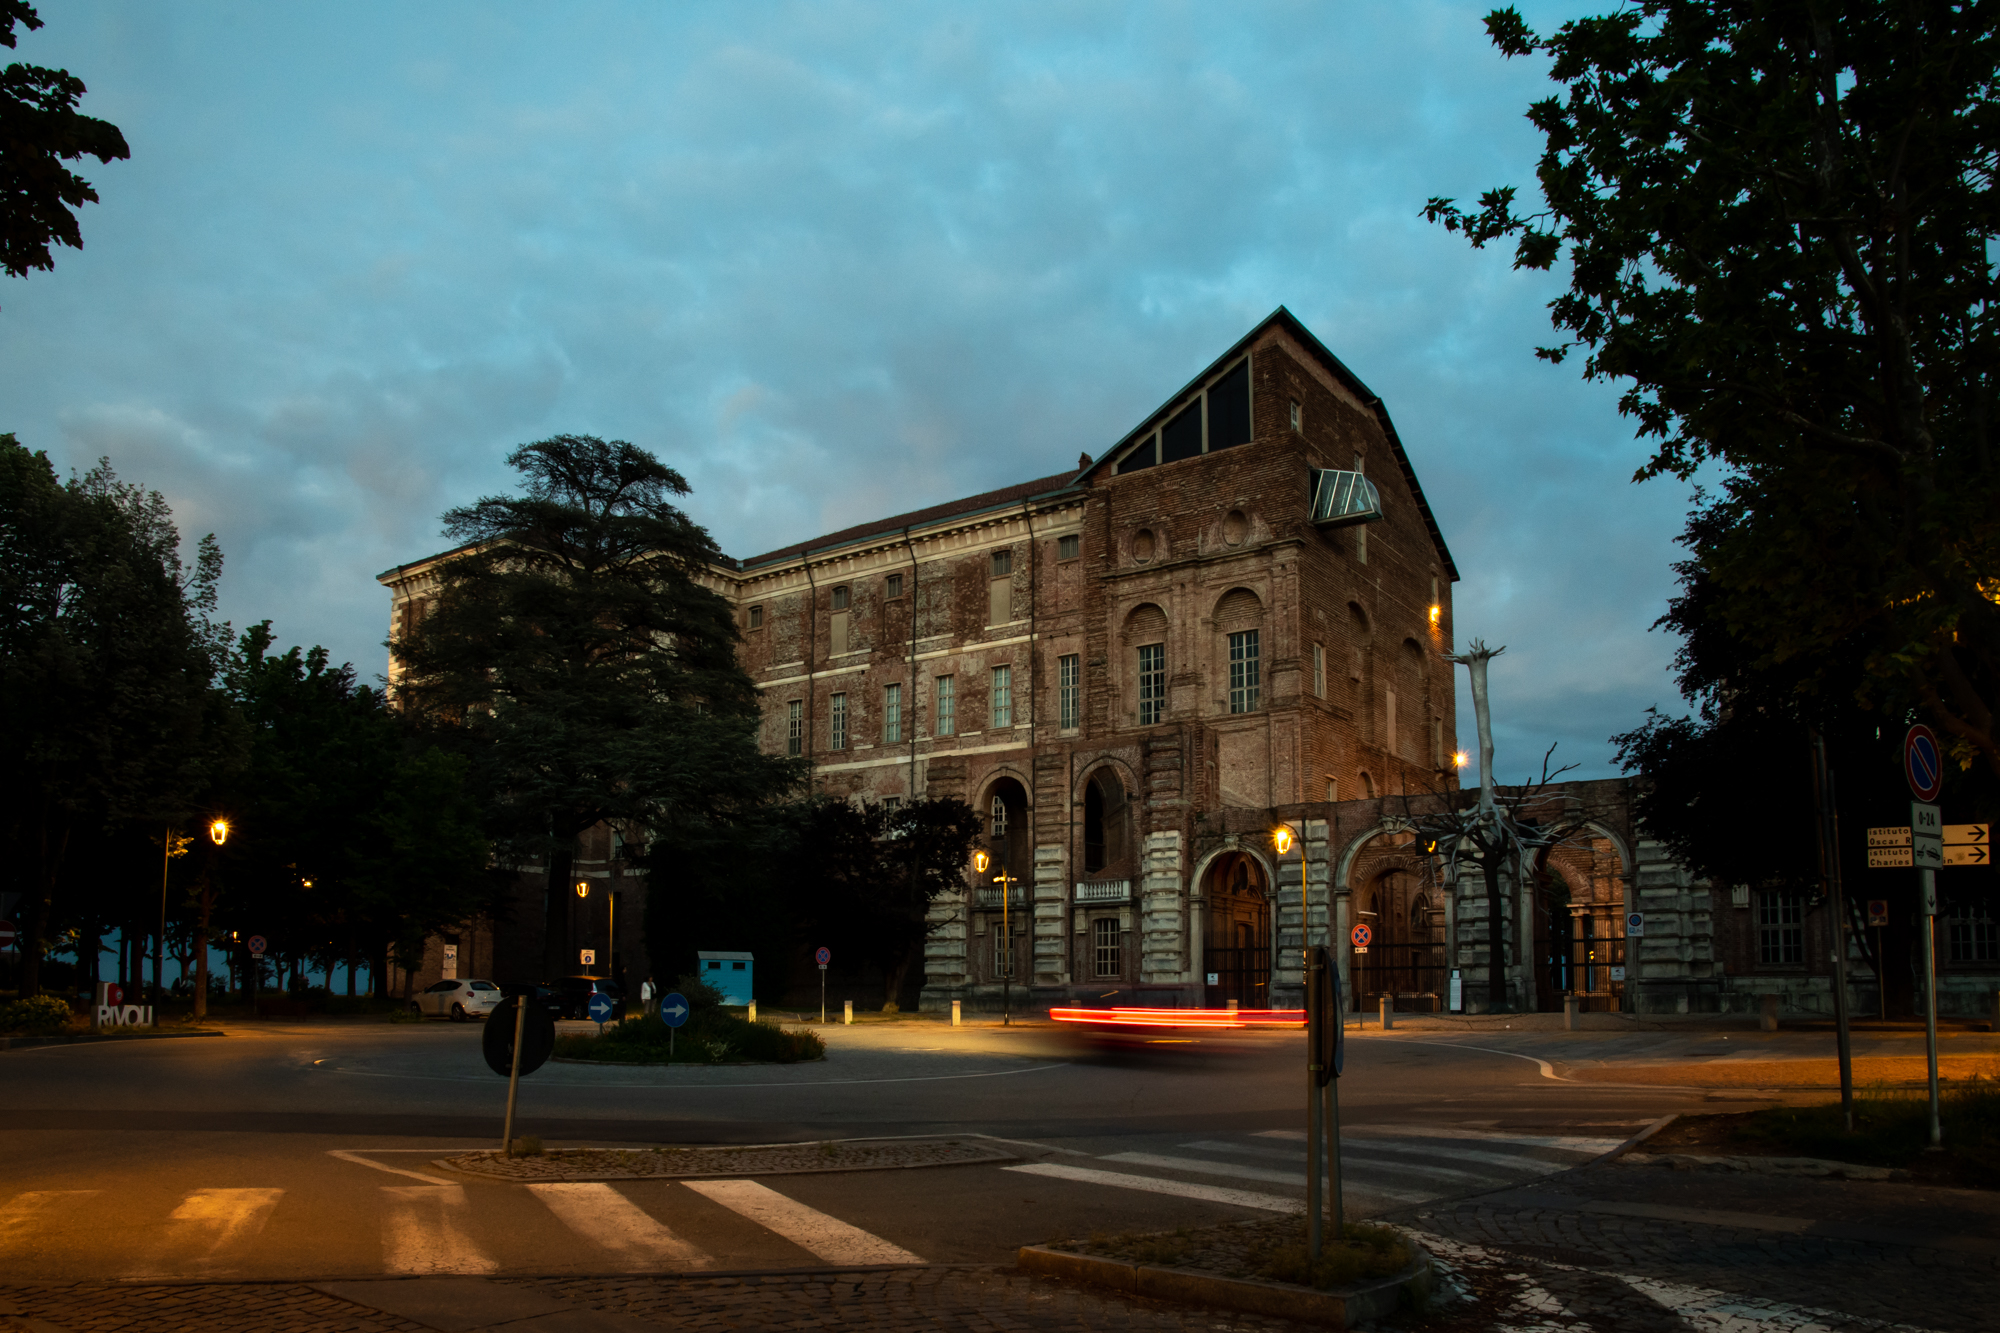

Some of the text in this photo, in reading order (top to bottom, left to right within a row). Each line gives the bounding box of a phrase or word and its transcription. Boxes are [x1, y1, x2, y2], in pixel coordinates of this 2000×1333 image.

[1918, 811, 1935, 827] 0-24
[1870, 858, 1909, 866] Charles
[98, 1005, 153, 1027] RIVOLI
